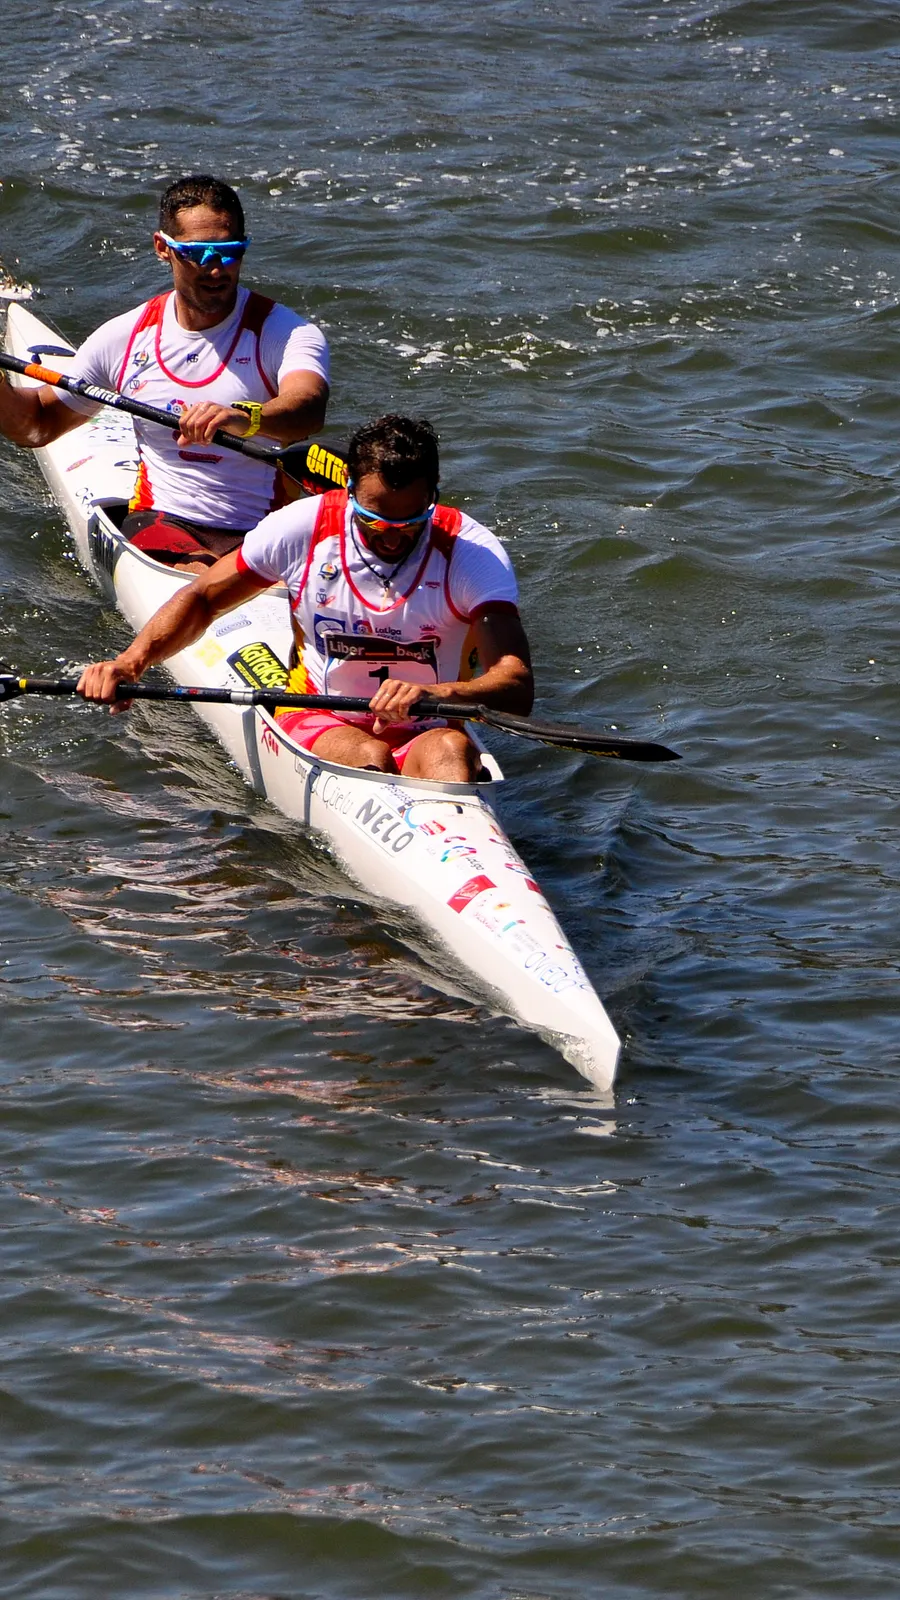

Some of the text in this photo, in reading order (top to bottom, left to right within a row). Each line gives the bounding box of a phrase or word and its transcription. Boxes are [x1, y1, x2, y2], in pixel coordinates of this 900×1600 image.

[375, 627, 401, 635] LaLiga
[329, 641, 365, 656] Liber
[368, 666, 389, 687] 1
[355, 798, 414, 853] NELO
